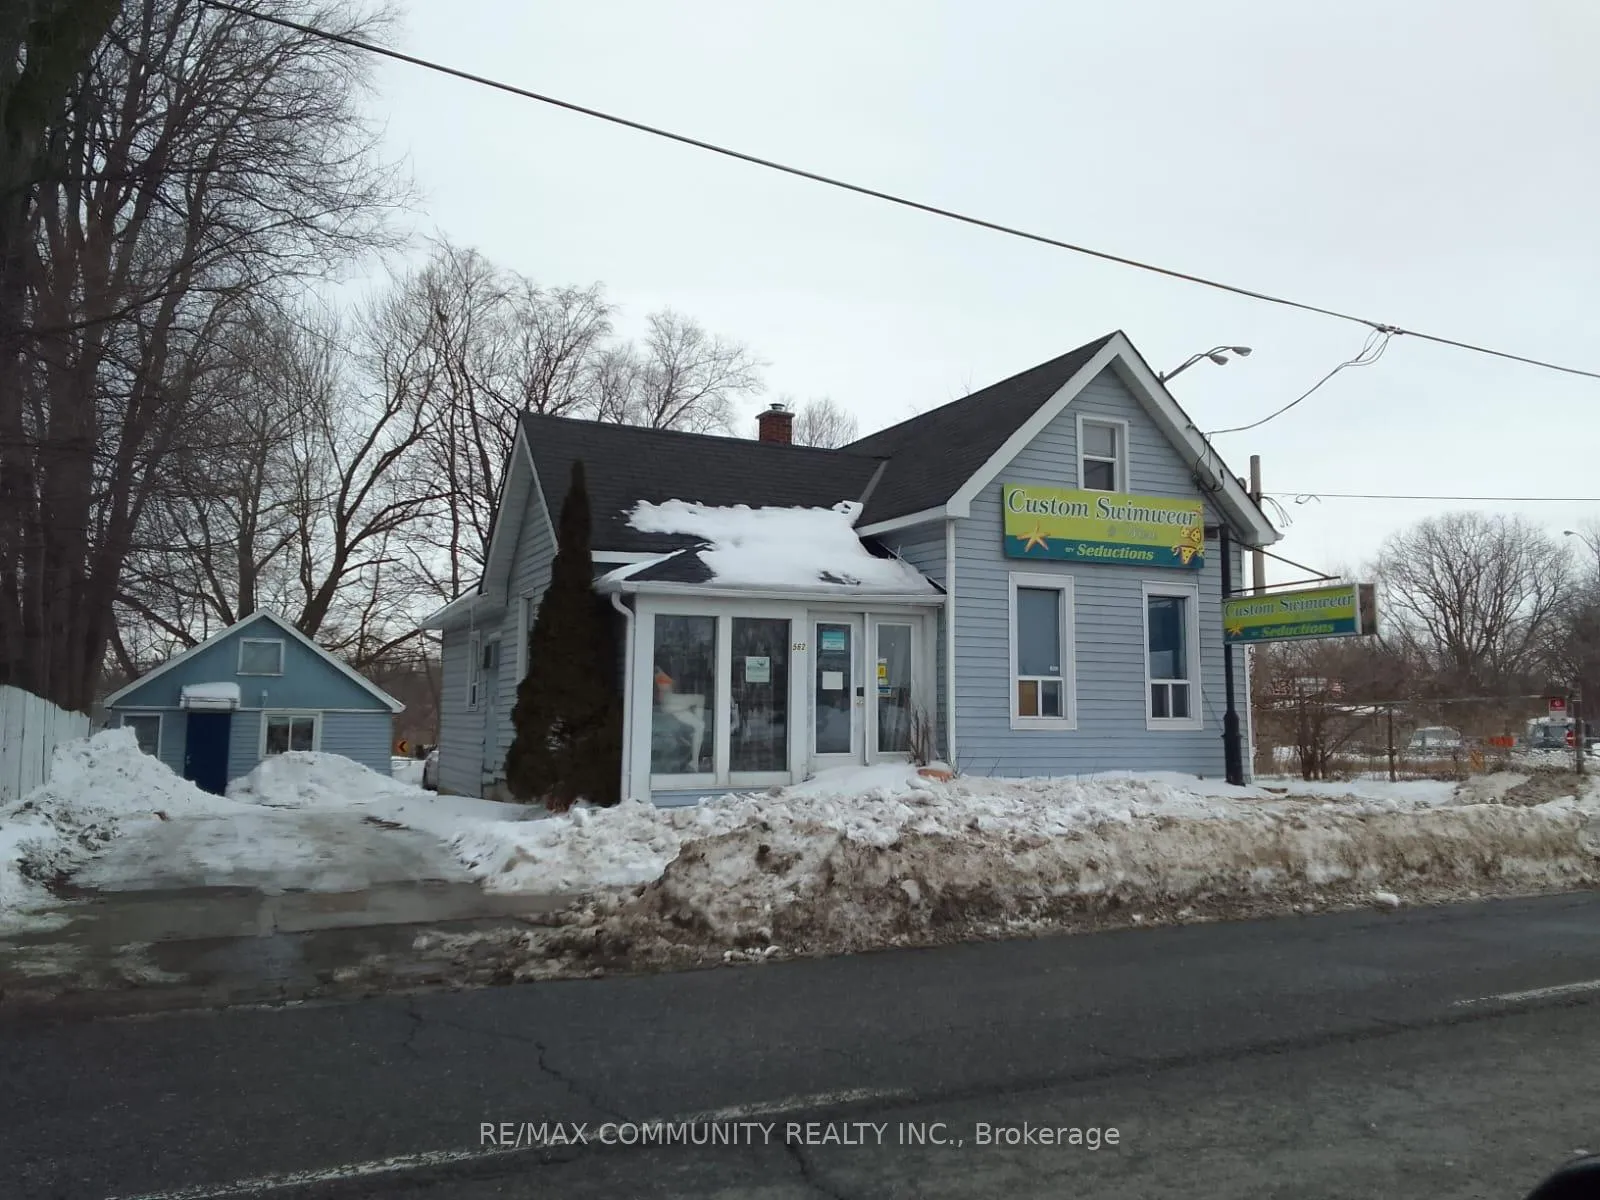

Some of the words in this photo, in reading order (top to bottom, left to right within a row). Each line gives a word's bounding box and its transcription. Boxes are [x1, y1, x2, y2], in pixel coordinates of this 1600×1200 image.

[1008, 489, 1089, 519] Custom
[1096, 497, 1197, 526] Swimwear
[1076, 543, 1154, 561] Seductions
[1224, 601, 1275, 618] Custom
[1279, 594, 1355, 613] Swimwear
[1262, 622, 1335, 638] Seductions
